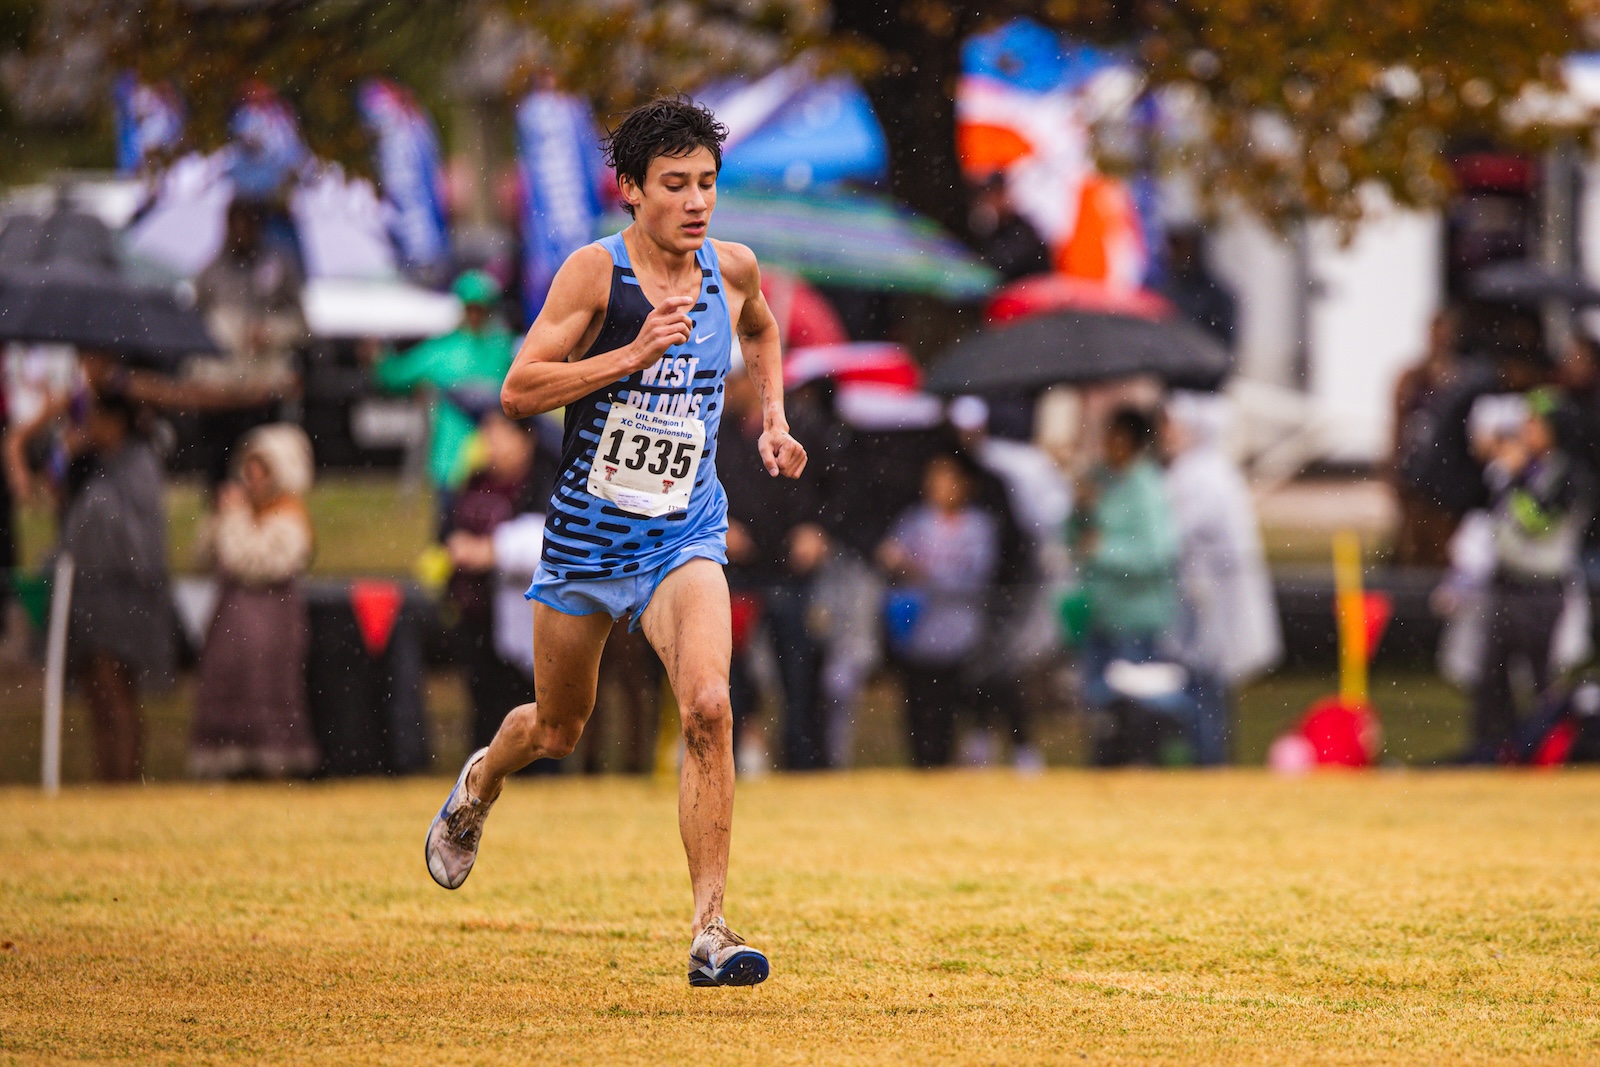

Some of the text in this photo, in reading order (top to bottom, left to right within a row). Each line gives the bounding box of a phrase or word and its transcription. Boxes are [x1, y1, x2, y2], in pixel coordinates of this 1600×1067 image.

[641, 357, 700, 387] WEST
[620, 417, 693, 439] XC Championship
[635, 412, 649, 422] UIL
[652, 416, 679, 427] Region
[602, 428, 696, 479] 1335
